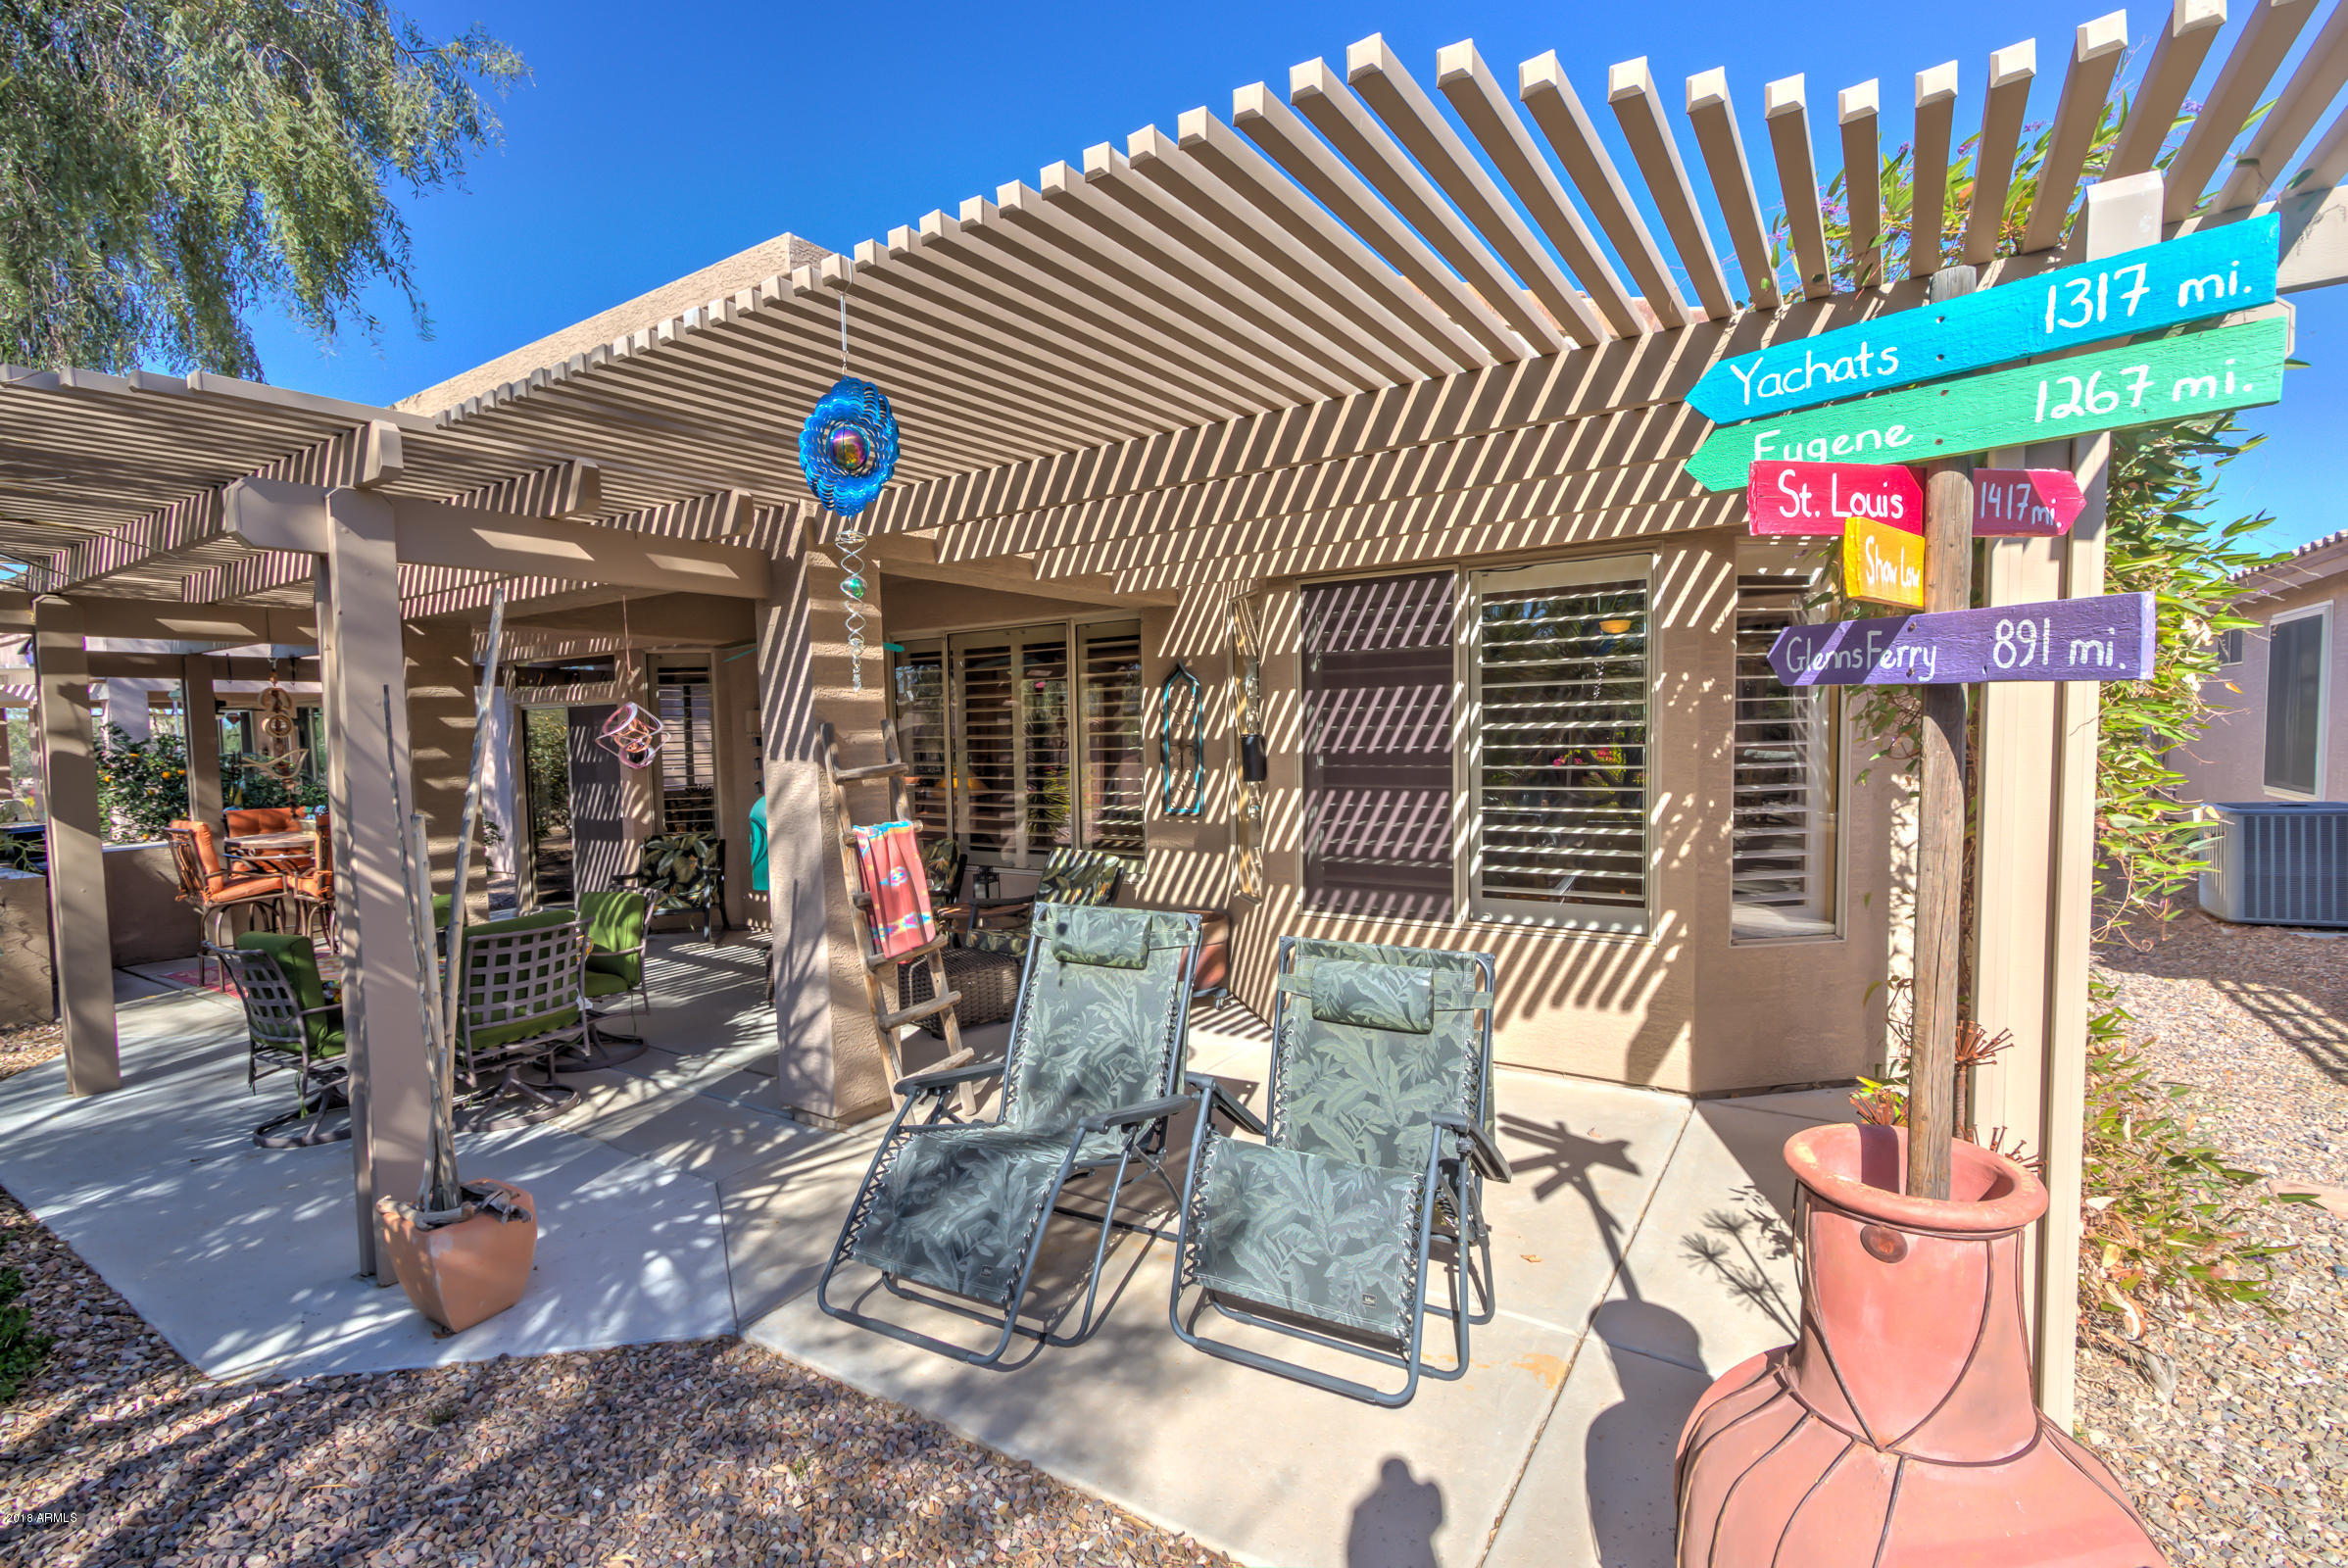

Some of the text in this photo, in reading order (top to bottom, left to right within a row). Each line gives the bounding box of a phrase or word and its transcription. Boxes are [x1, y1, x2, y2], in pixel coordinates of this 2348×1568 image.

[1730, 260, 2252, 406] Yachats 1317 mi.
[1754, 359, 2253, 463] Eugene 1267 mi.
[1778, 468, 2063, 526] St. Louis 1417 mi.
[1865, 535, 1921, 589] Show Low
[1993, 617, 2050, 668] 891
[2069, 627, 2127, 669] mi.
